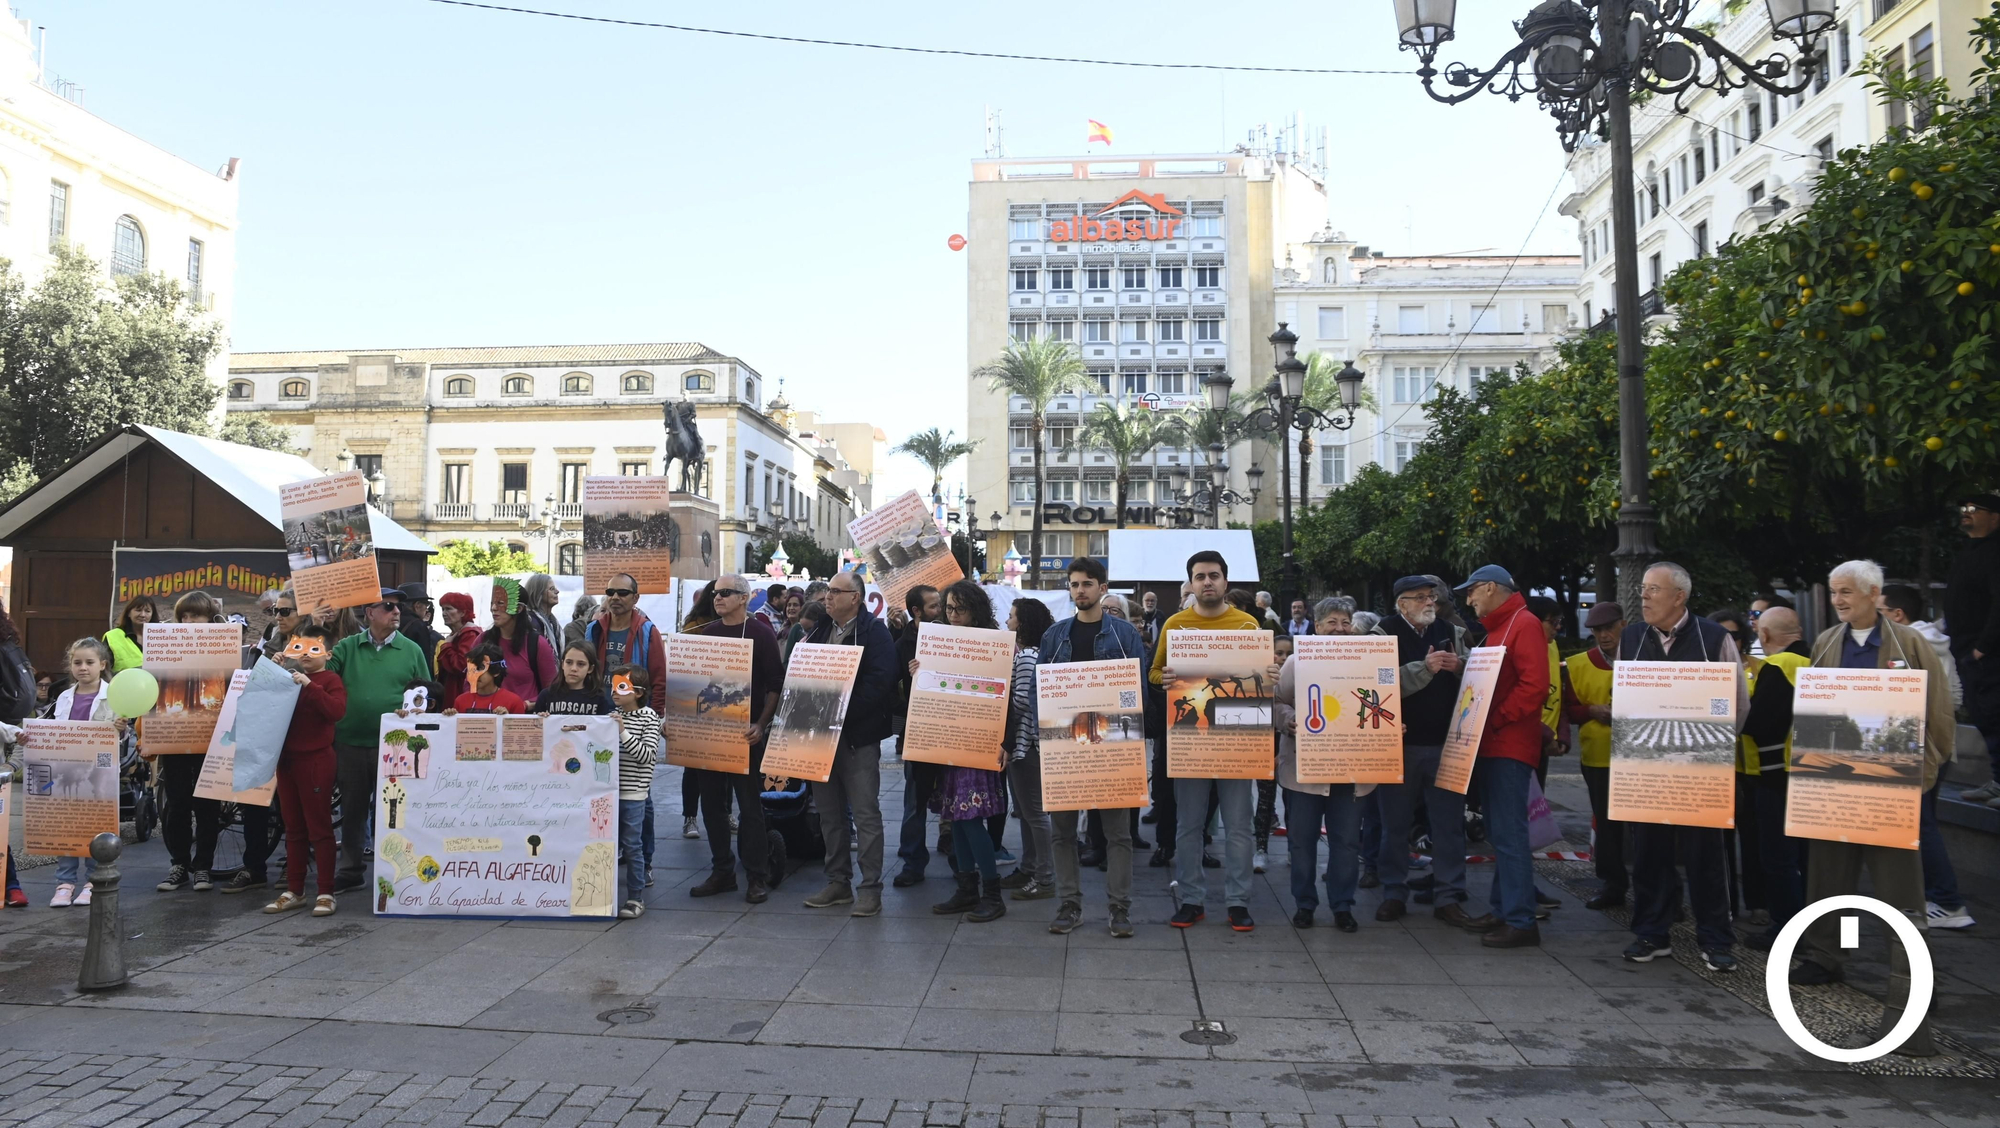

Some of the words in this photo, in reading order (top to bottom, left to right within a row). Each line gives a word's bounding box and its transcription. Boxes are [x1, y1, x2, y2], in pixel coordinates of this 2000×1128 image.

[1051, 215, 1181, 242] albasur
[1082, 244, 1148, 252] inmobiliarias
[344, 526, 354, 542] 3
[119, 562, 222, 602] Emergencia
[227, 564, 290, 595] Climát
[959, 646, 989, 654] tropicales
[550, 702, 598, 714] ANDSCAPE
[442, 861, 480, 878] AFA
[399, 884, 423, 906] Con
[429, 882, 443, 906] la
[447, 887, 504, 913] Capacidad
[511, 892, 527, 906] de
